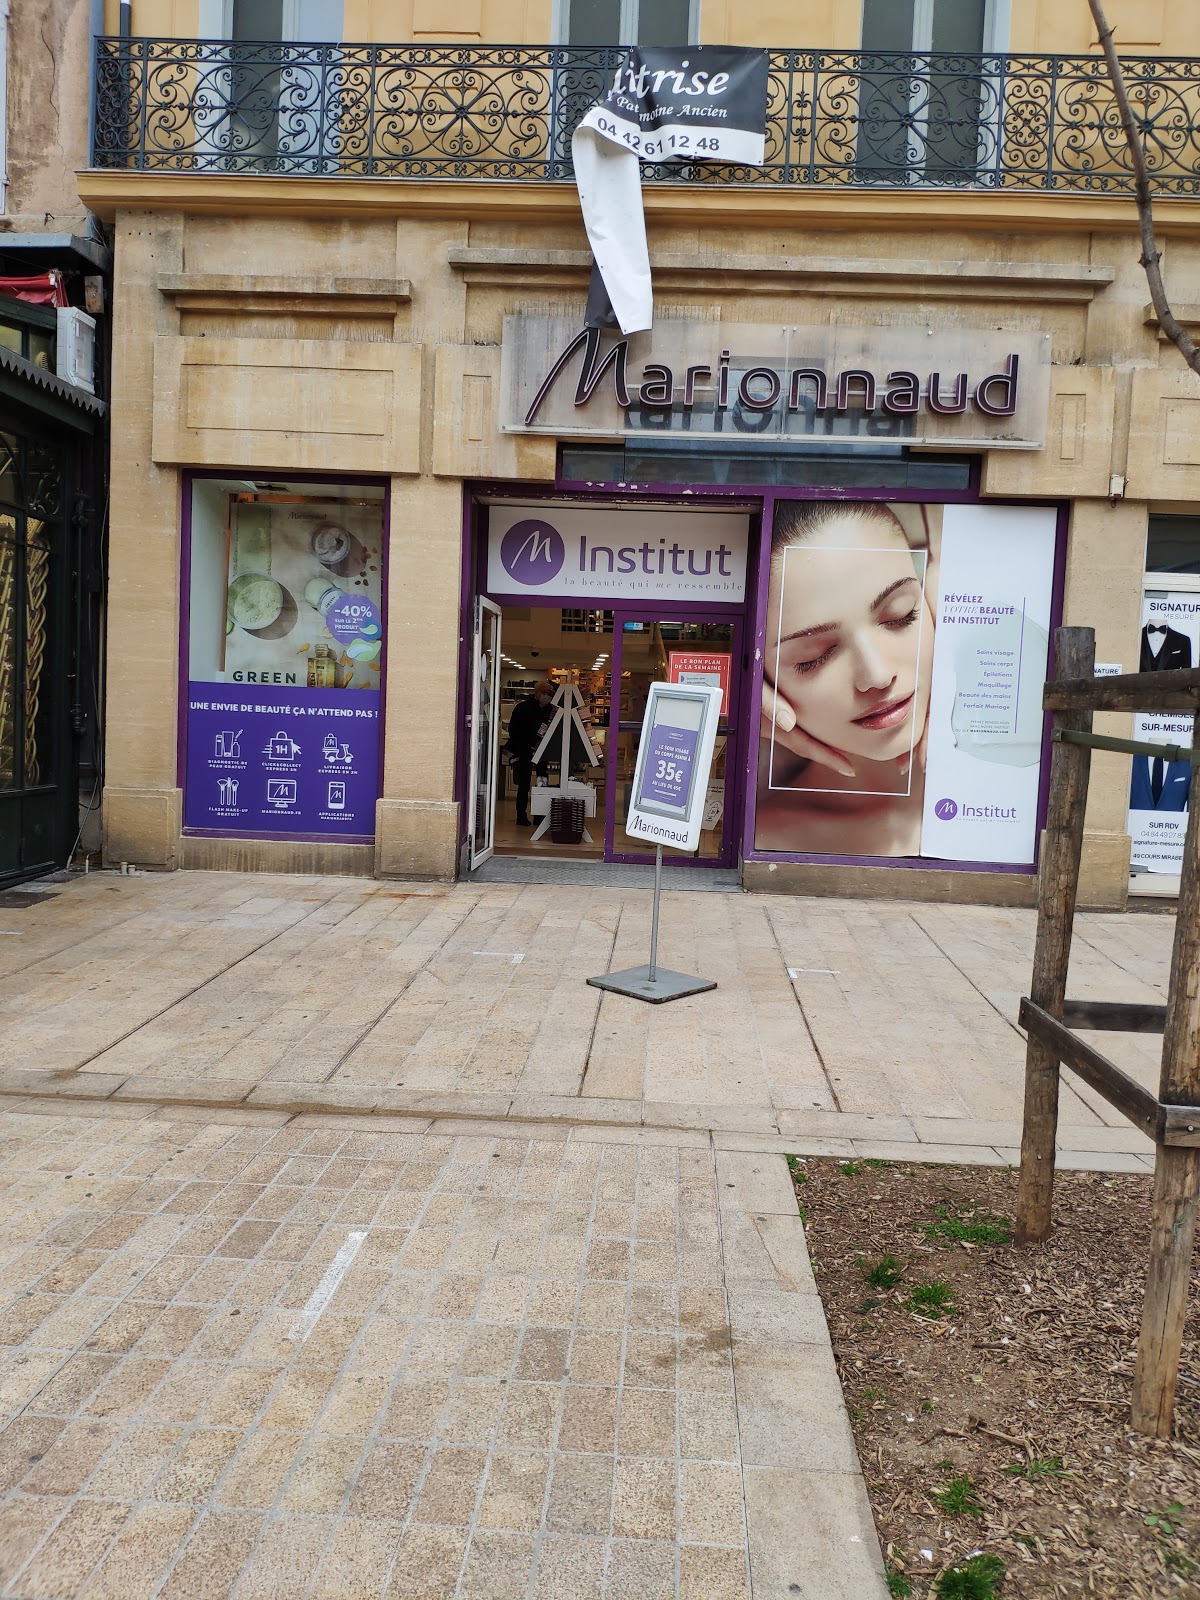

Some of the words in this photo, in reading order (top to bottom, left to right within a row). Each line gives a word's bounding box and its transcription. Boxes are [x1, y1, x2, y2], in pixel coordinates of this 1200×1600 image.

[676, 104, 728, 118] Ancien
[598, 118, 617, 136] 04
[622, 132, 640, 150] 42
[644, 140, 663, 155] 61
[668, 134, 690, 148] 12
[696, 137, 720, 151] 48
[524, 327, 1019, 426] Marionnaud
[579, 536, 732, 577] Institut
[564, 576, 576, 586] la
[582, 578, 623, 587] beauté
[630, 580, 650, 590] qui
[678, 582, 742, 591] ressemble
[944, 592, 984, 603] RÉVÉLEZ
[334, 605, 372, 618] -40%
[980, 605, 1015, 614] BEAUTÉ
[958, 616, 1000, 624] INSTITUT
[232, 670, 296, 684] GREEN
[190, 702, 209, 710] UNE
[211, 703, 239, 712] ENVIE
[255, 705, 291, 714] BEAUTÉ
[293, 707, 306, 716] ÇA
[308, 707, 354, 717] N'ATTEND
[355, 710, 373, 718] PAS
[275, 744, 288, 754] 1H
[655, 760, 683, 782] 35€
[962, 804, 1016, 818] Institut
[628, 815, 689, 843] Marionnaud
